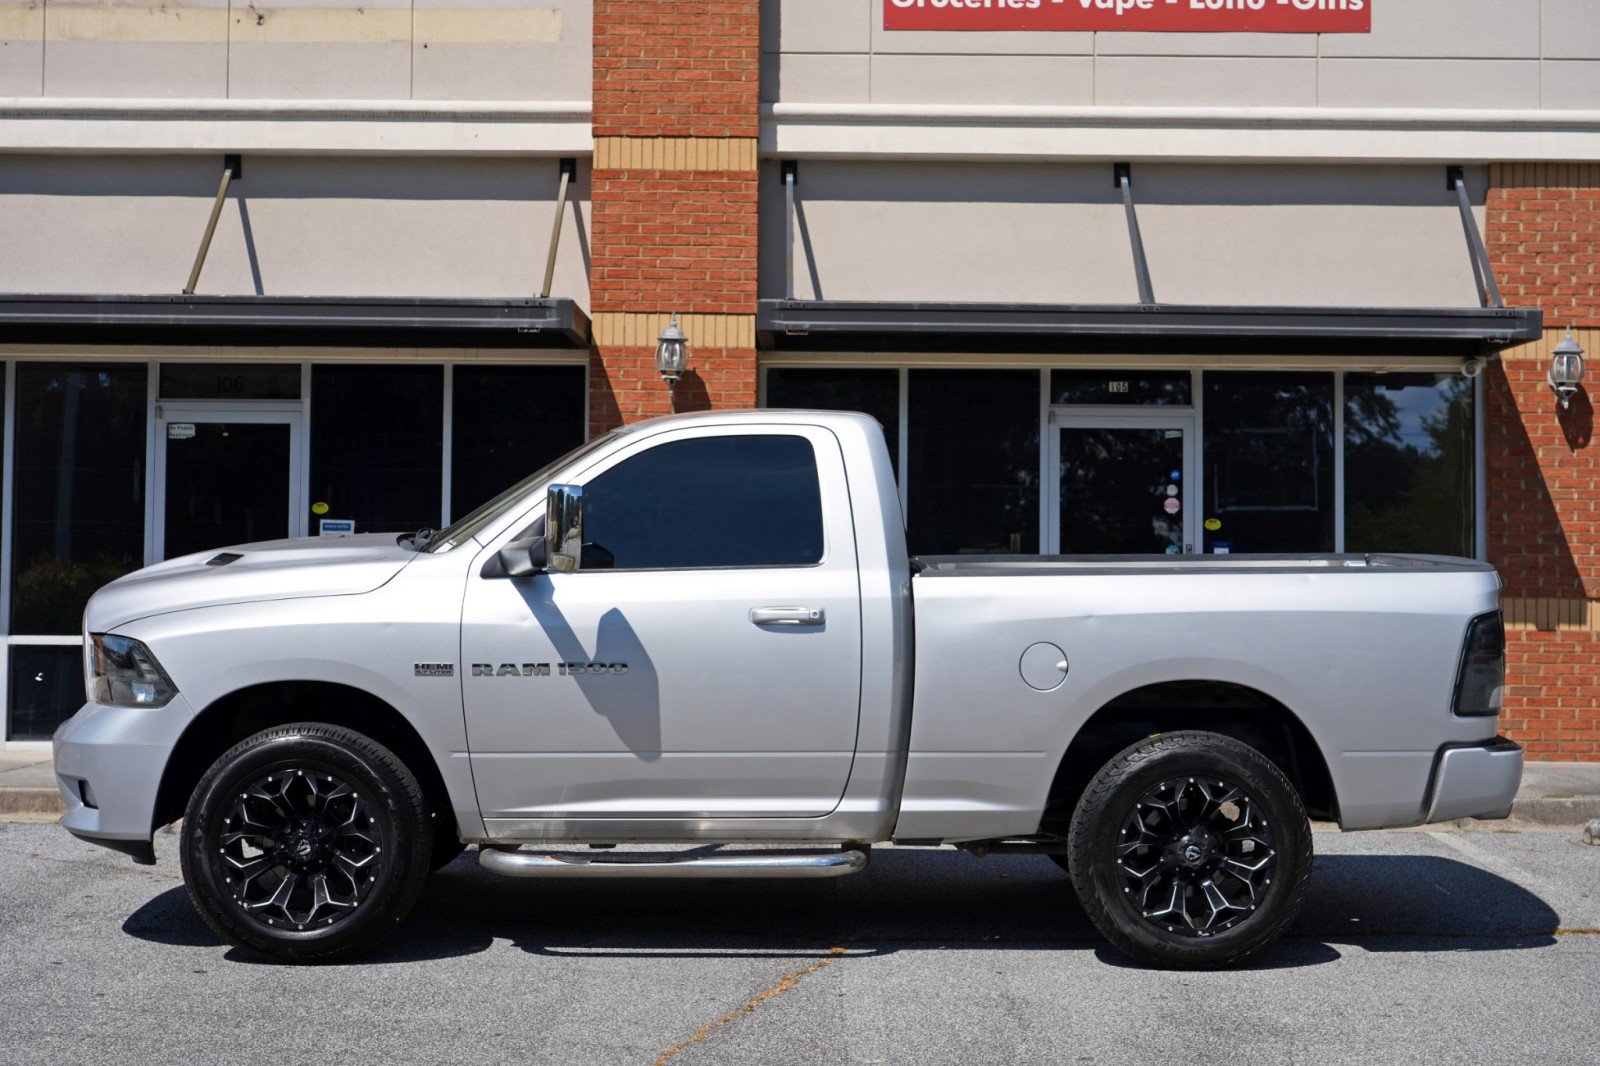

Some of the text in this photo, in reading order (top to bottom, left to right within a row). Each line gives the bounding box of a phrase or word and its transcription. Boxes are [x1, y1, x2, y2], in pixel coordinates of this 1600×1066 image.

[217, 375, 244, 393] 106
[1110, 382, 1127, 392] 105
[472, 662, 630, 677] RAM 1500
